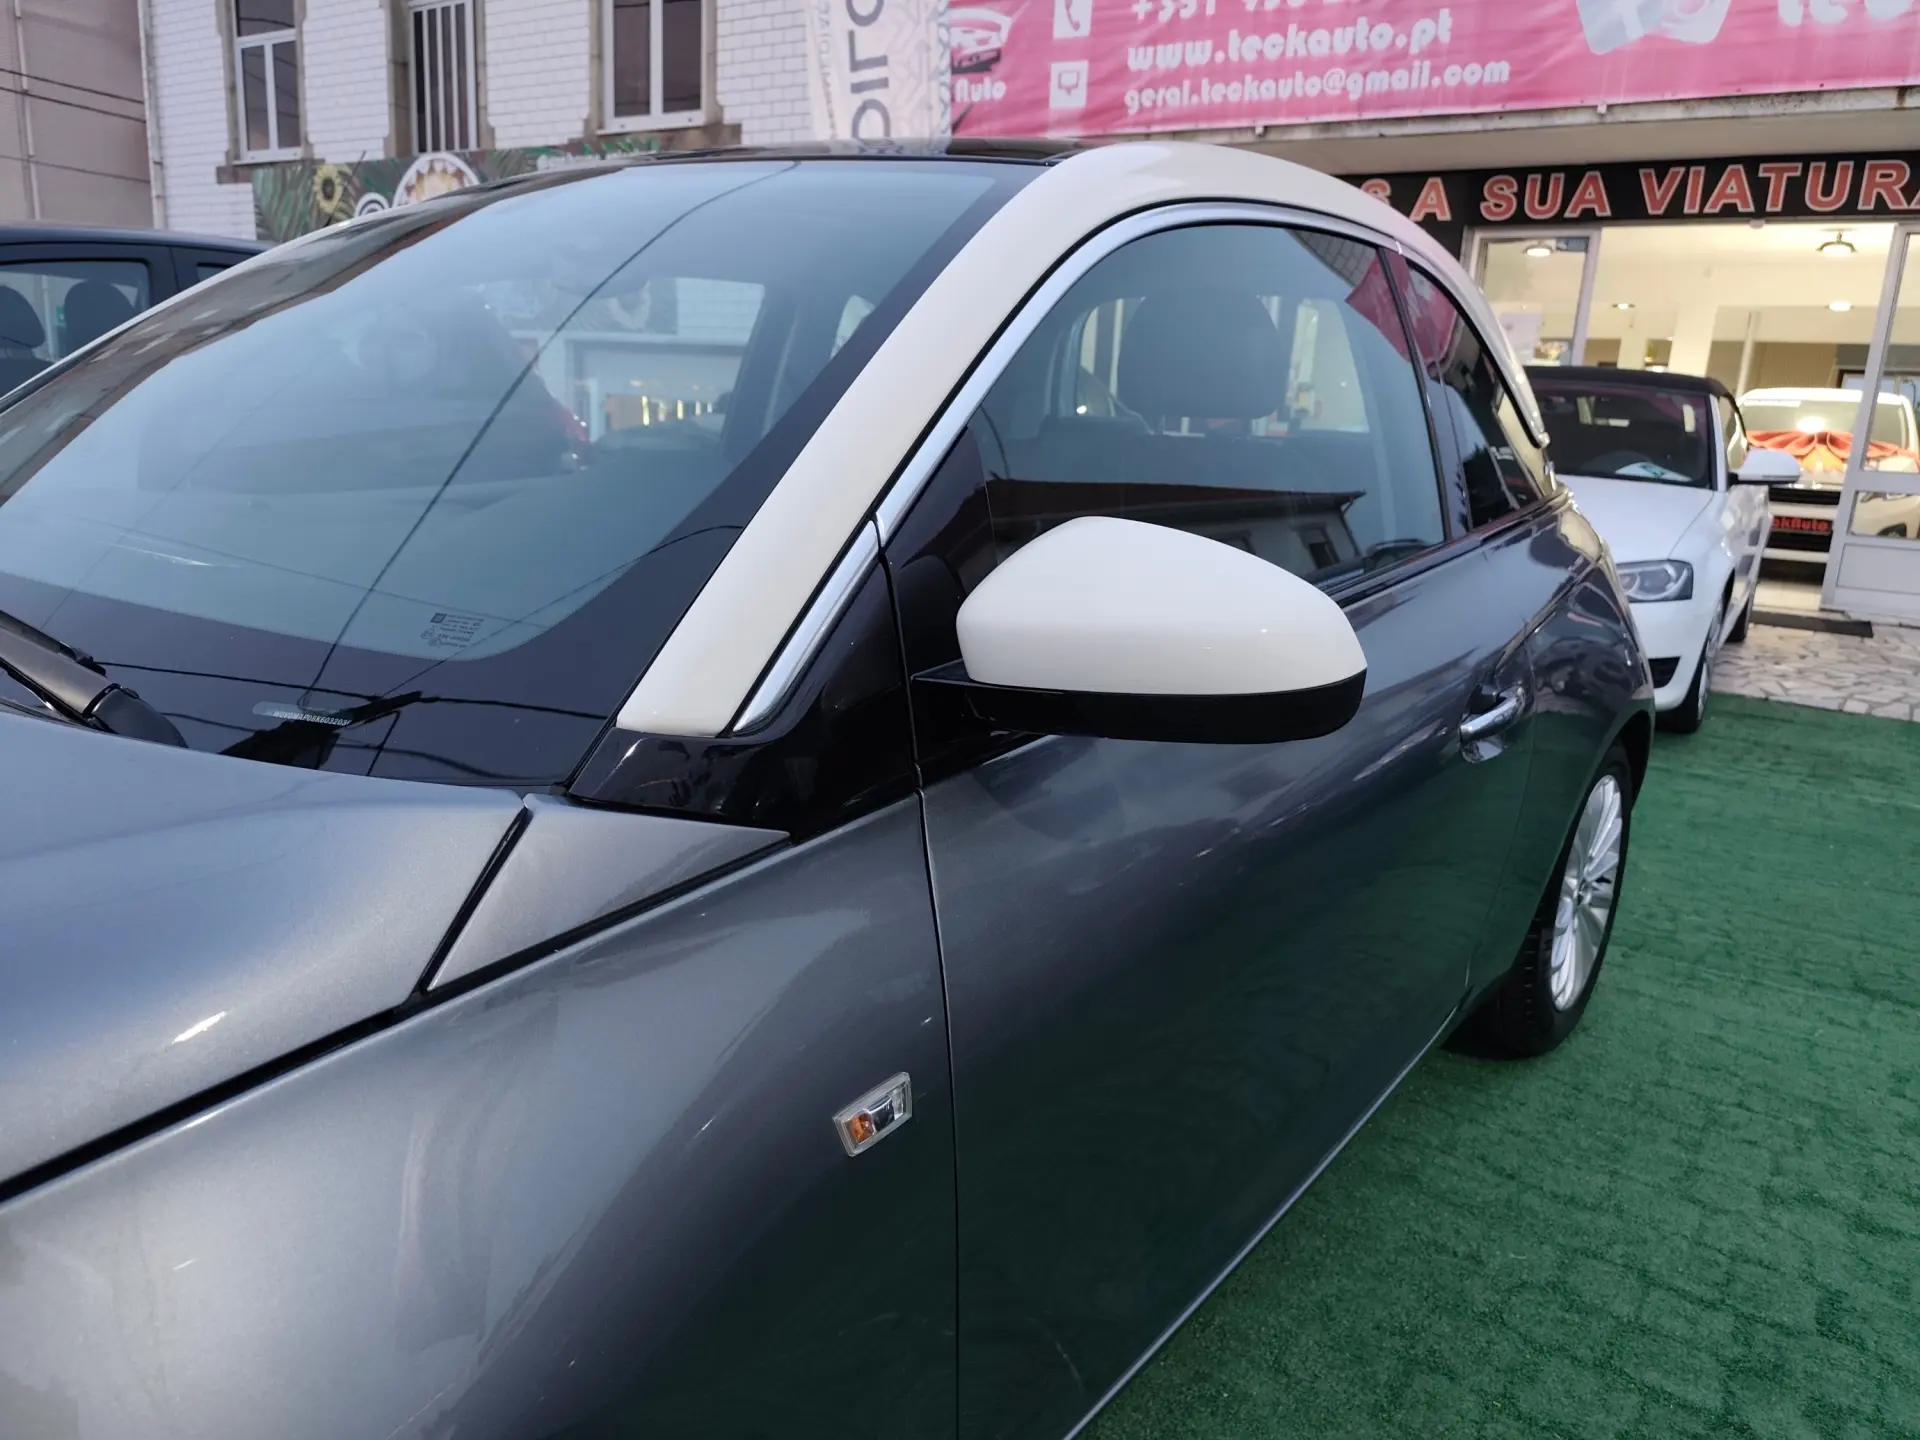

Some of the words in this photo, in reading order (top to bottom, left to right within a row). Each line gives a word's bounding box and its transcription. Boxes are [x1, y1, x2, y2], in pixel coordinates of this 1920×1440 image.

[1127, 8, 1452, 71] www.teckauto.pt
[1124, 60, 1511, 116] geral.teckauto@gmail.com
[1409, 176, 1452, 222] A
[1479, 170, 1612, 222] SUA
[1638, 159, 1920, 216] VIATUR
